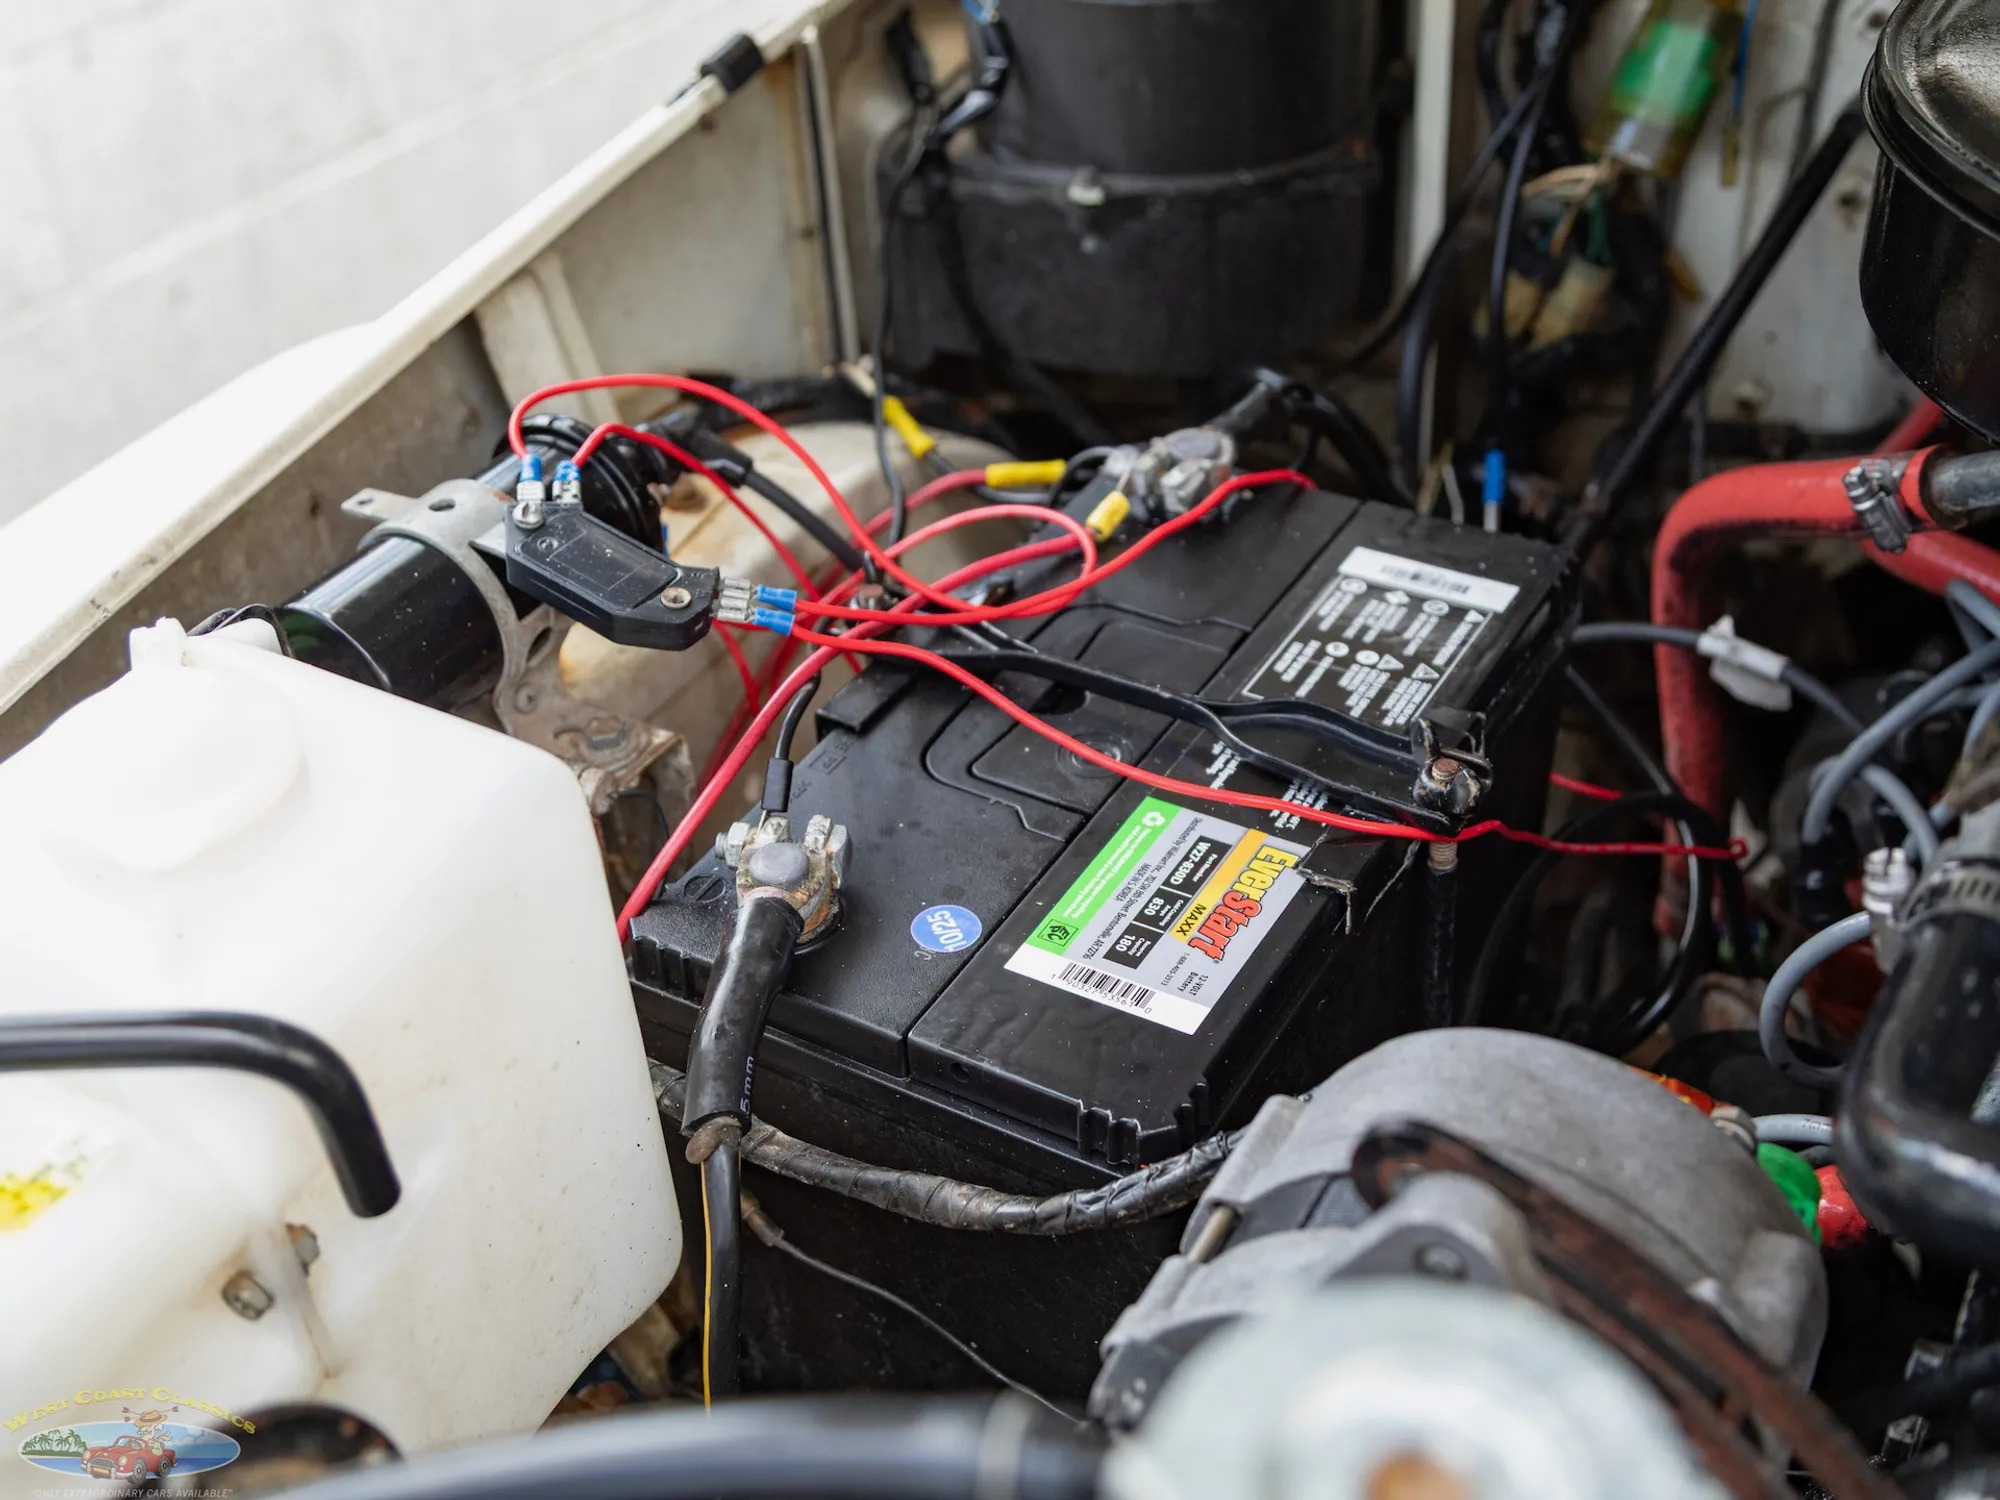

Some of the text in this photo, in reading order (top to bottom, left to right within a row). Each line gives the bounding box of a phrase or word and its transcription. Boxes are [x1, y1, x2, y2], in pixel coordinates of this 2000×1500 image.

[1167, 840, 1212, 885] W27-830D
[1204, 853, 1218, 864] Part
[1134, 862, 1151, 877] MADE
[1114, 885, 1133, 902] KOREA
[1188, 844, 1300, 962] EverStart
[1142, 896, 1165, 916] 830
[1174, 903, 1208, 936] MAXX
[926, 909, 968, 952] 10/25
[1113, 932, 1136, 952] 180
[1126, 936, 1146, 956] Capacity
[1176, 971, 1198, 992] Battery
[1187, 974, 1209, 995] 12-VOLT
[1064, 979, 1098, 994] 90327
[1101, 992, 1134, 1007] 53561
